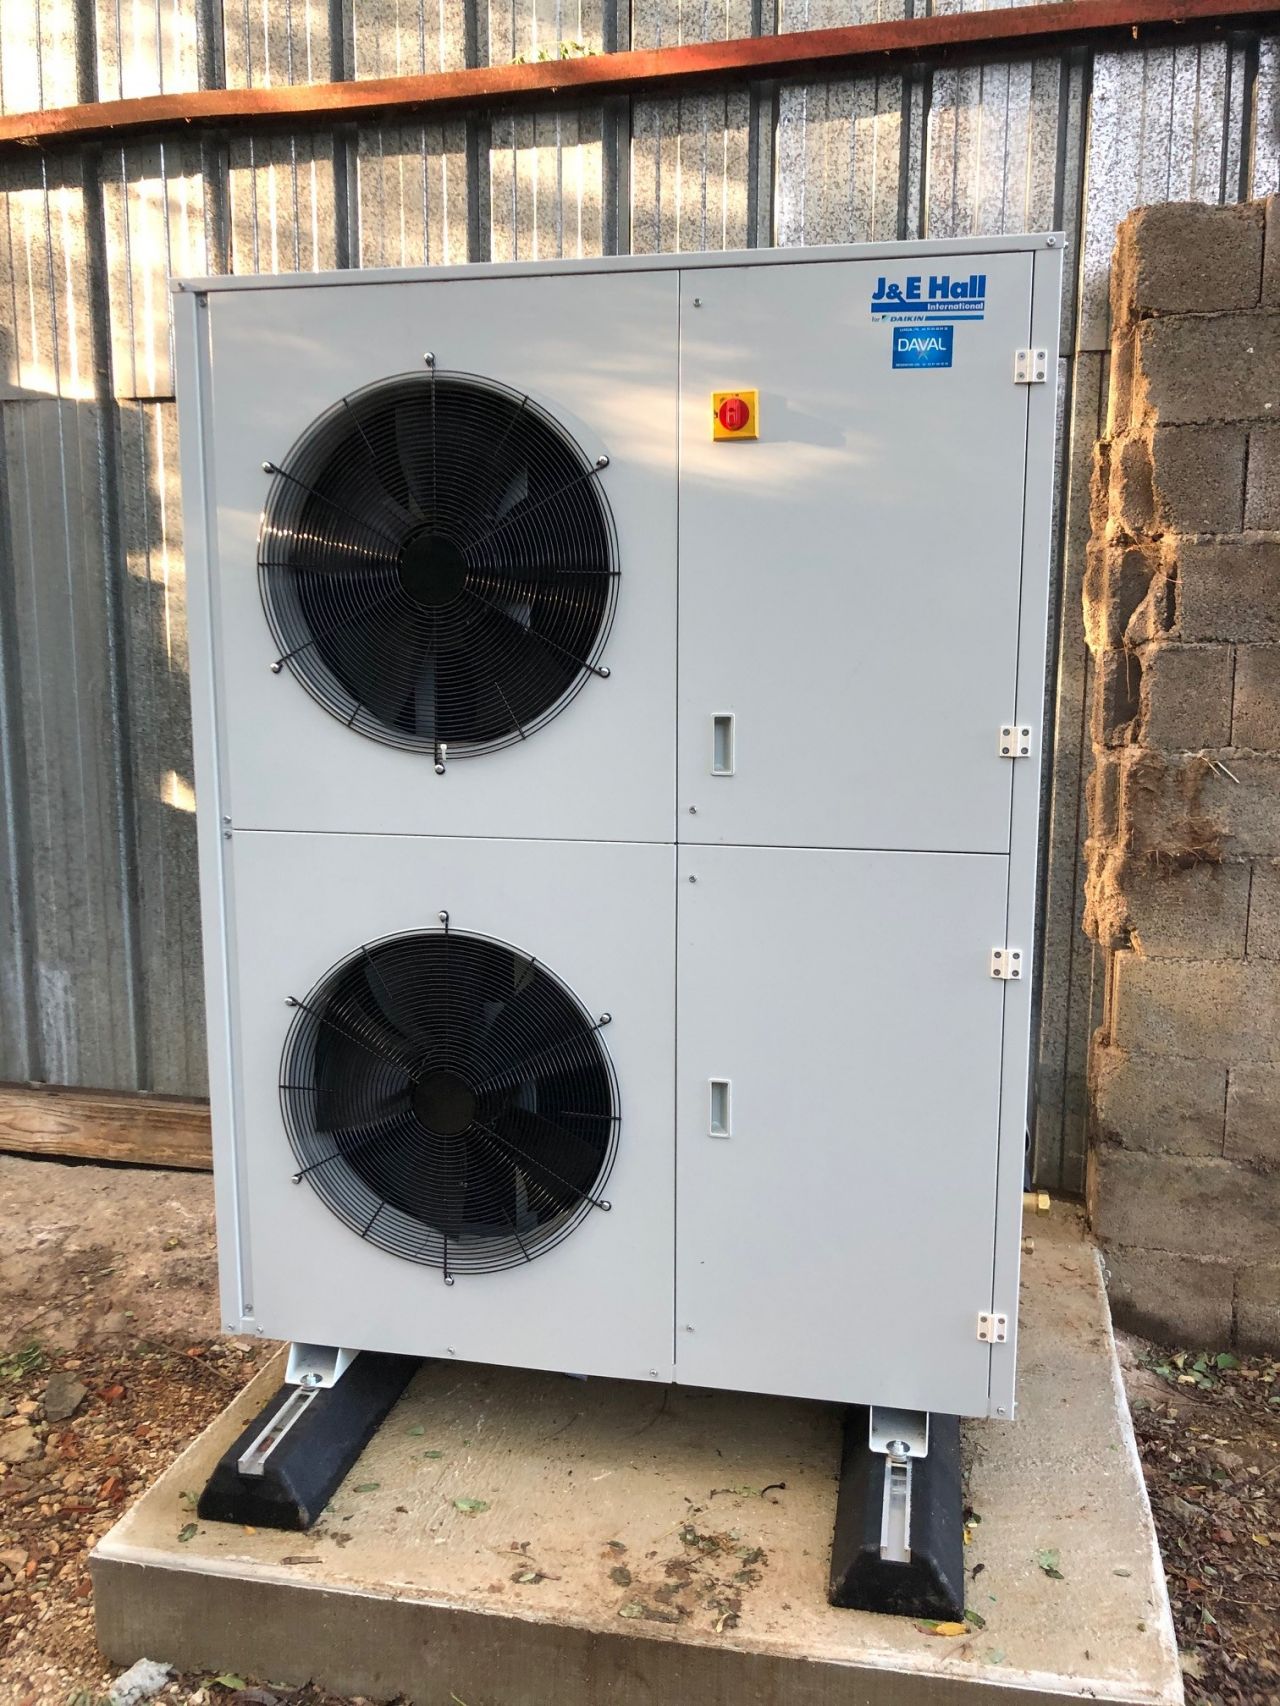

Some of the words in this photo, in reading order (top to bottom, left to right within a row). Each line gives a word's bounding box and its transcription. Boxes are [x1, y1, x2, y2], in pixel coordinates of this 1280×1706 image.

[872, 276, 921, 302] J&E
[928, 275, 986, 299] Hall
[927, 302, 984, 311] International
[898, 337, 947, 352] DAVAL
